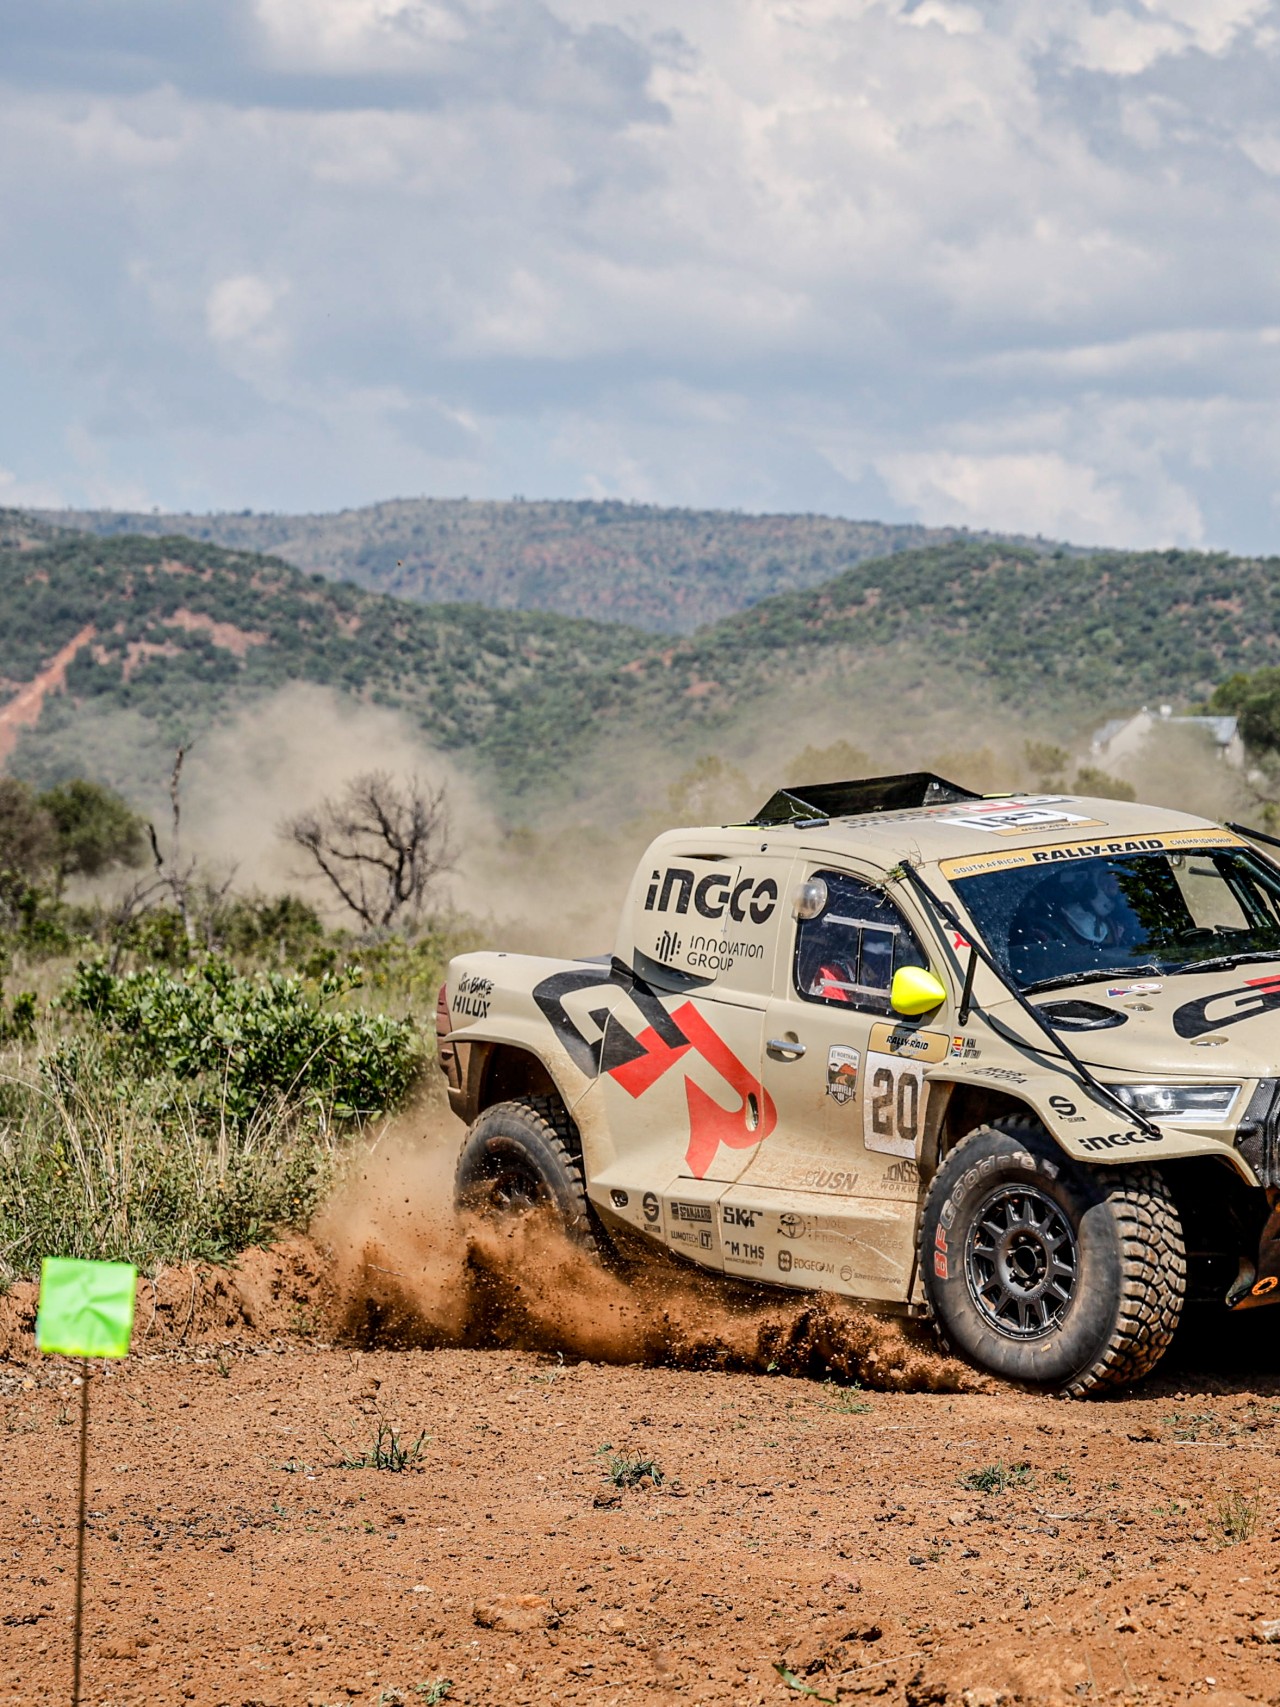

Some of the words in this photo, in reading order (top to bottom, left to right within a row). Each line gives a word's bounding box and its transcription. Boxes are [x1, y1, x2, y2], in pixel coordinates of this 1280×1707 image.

[953, 862, 986, 875] SOUTH
[986, 856, 1026, 869] AFRICAN
[1032, 839, 1164, 863] RALLY-RAID
[1170, 837, 1233, 846] CHAMPIONSHIP
[686, 952, 734, 972] GROUP
[452, 995, 491, 1018] HILUX
[886, 1035, 929, 1050] RALLY-RAID
[872, 1067, 918, 1140] 20
[815, 1172, 858, 1190] USN
[723, 1206, 763, 1228] SKF
